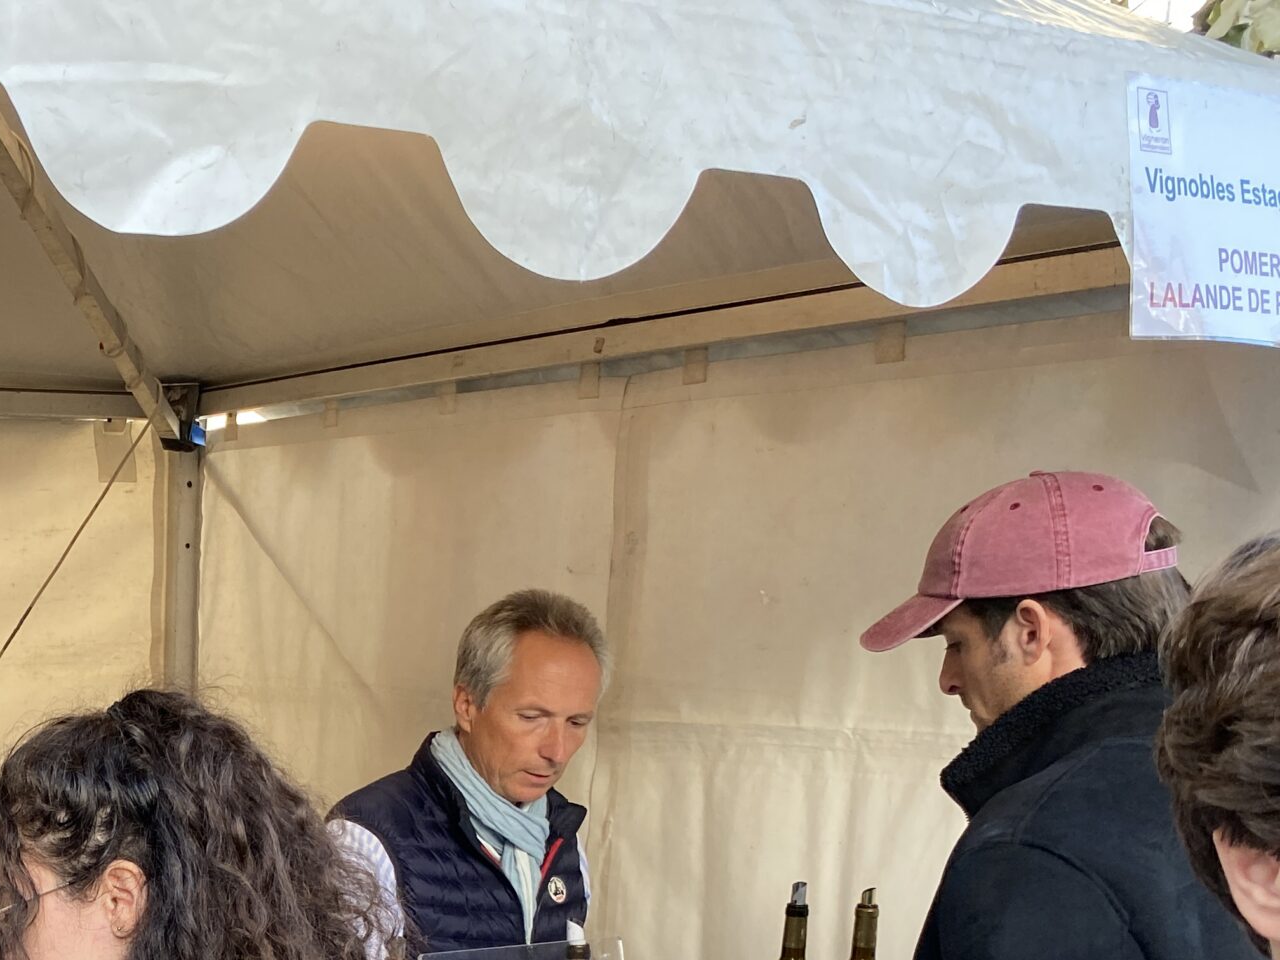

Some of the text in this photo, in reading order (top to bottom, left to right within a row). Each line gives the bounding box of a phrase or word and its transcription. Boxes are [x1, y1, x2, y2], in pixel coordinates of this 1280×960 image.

[1145, 166, 1280, 208] Vignobles Esta
[1149, 281, 1244, 311] LALANDE
[1248, 288, 1271, 315] DE
